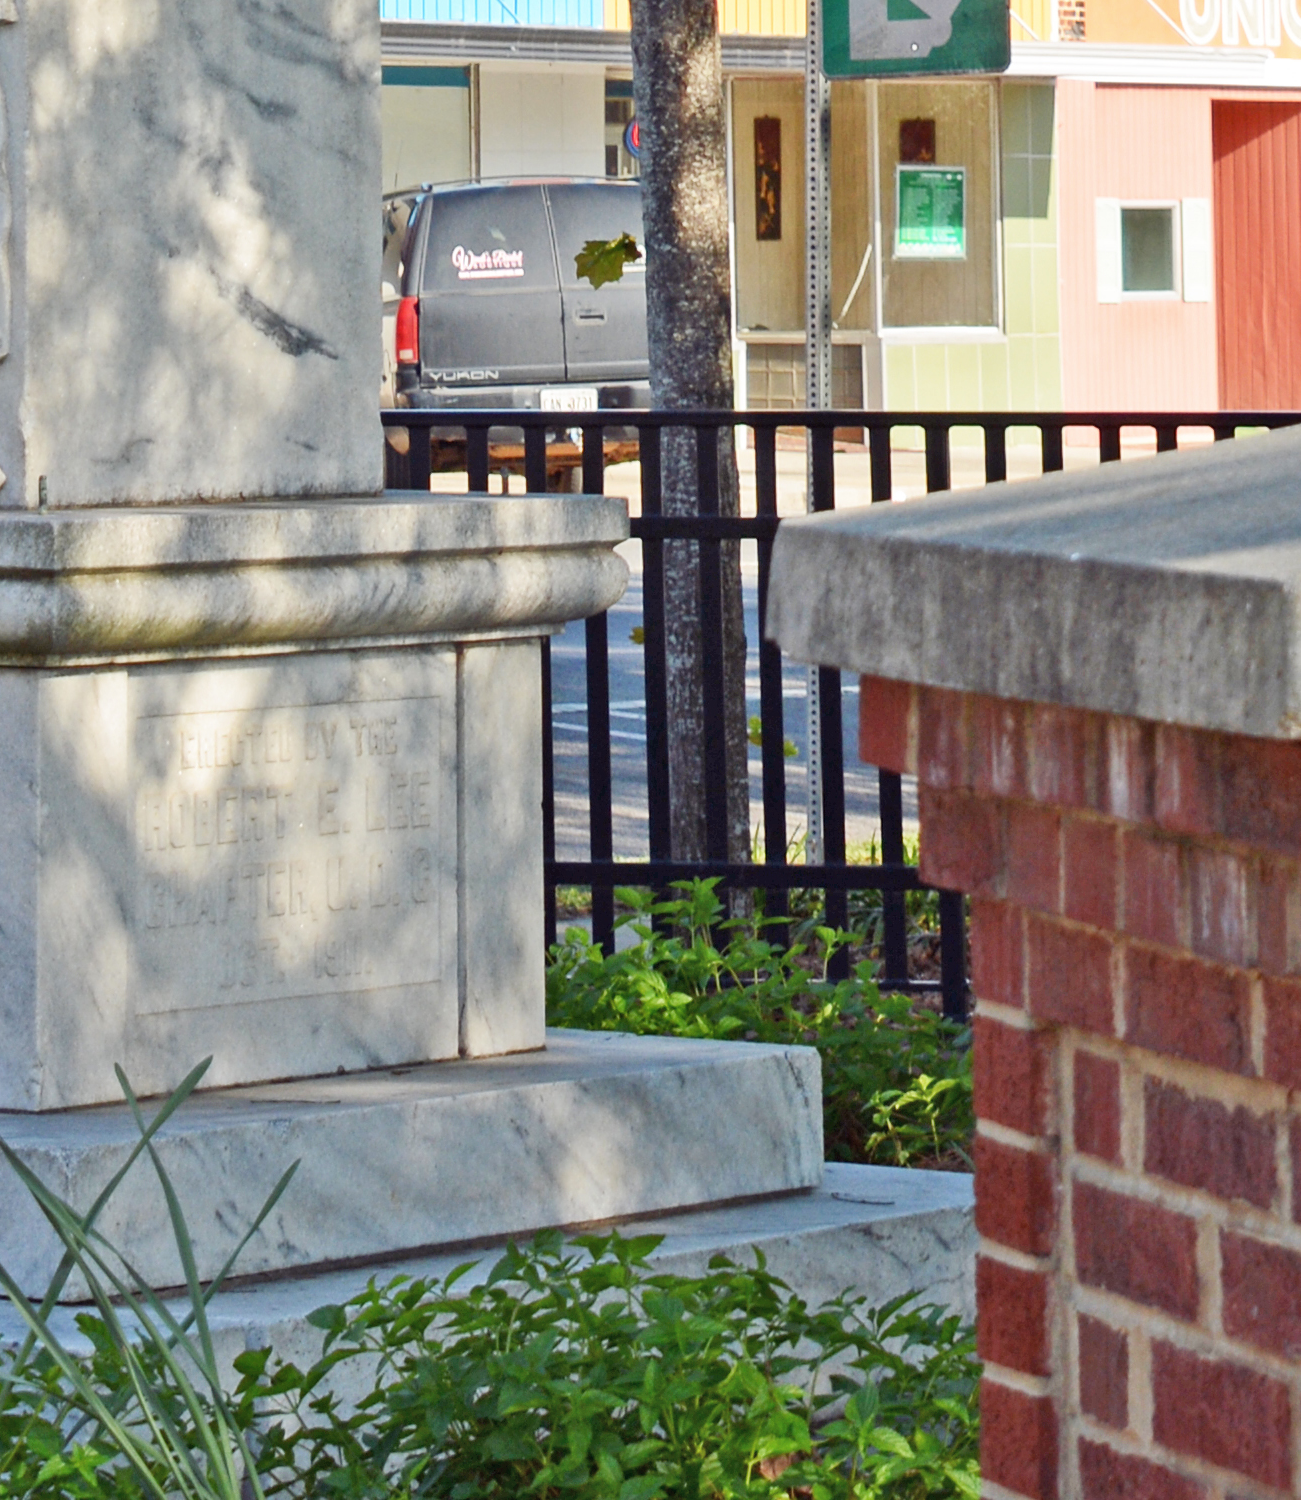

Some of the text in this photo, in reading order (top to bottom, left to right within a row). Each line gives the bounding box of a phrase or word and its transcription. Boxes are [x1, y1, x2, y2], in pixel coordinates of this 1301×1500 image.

[429, 370, 499, 382] YUKON
[179, 717, 398, 770] ERECTED BY THE
[144, 769, 431, 852] ROBERT E. LEE
